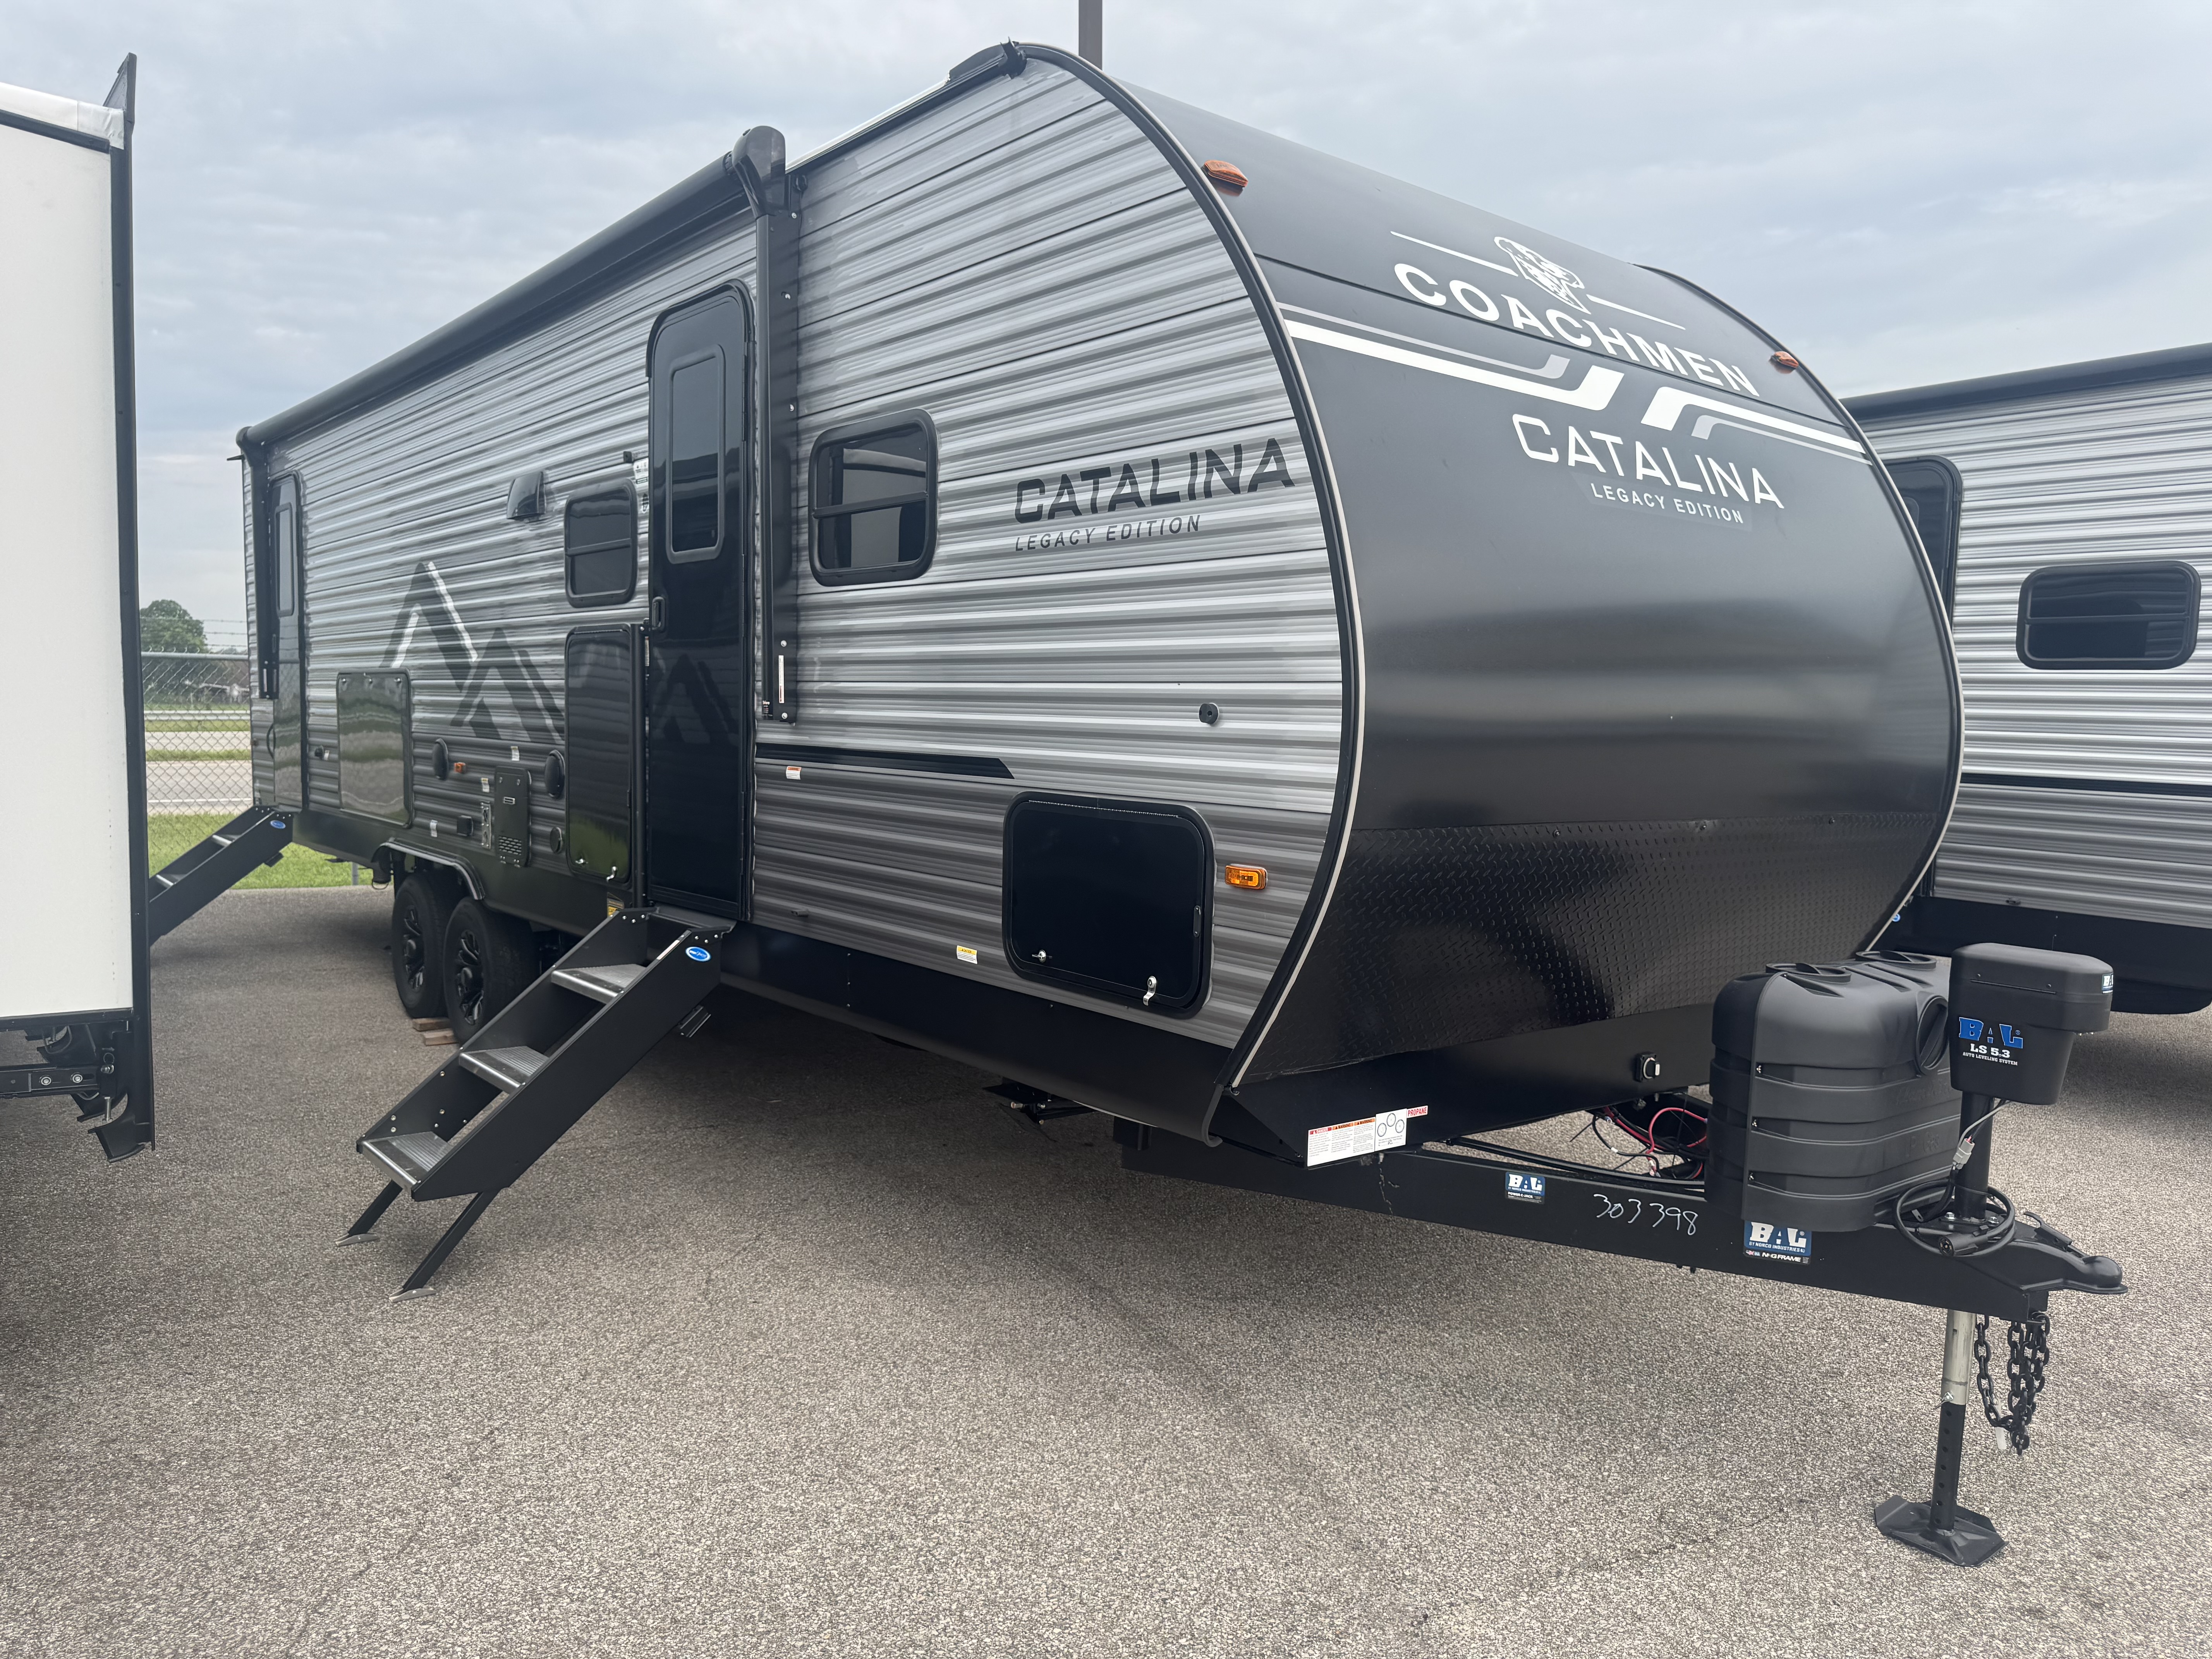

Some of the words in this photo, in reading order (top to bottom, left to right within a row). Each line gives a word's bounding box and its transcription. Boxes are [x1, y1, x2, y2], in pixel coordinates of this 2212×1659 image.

[1394, 263, 1759, 396] COACHMEN
[1512, 413, 1784, 508] CATALINA
[1014, 438, 1295, 523] CATALINA
[1590, 483, 1665, 510] LEGACY
[1673, 498, 1743, 524] EDITION
[1015, 527, 1096, 551] LEGACY
[1106, 515, 1200, 541] EDITION
[1959, 1017, 2023, 1049] BAL
[1970, 1043, 1987, 1054] LS
[1990, 1047, 2010, 1058] 5.3
[1976, 1054, 1997, 1062] LEVELING
[1408, 1107, 1427, 1116] PROPANE
[1508, 1174, 1542, 1191] BAL
[1750, 1222, 1806, 1248] BAL
